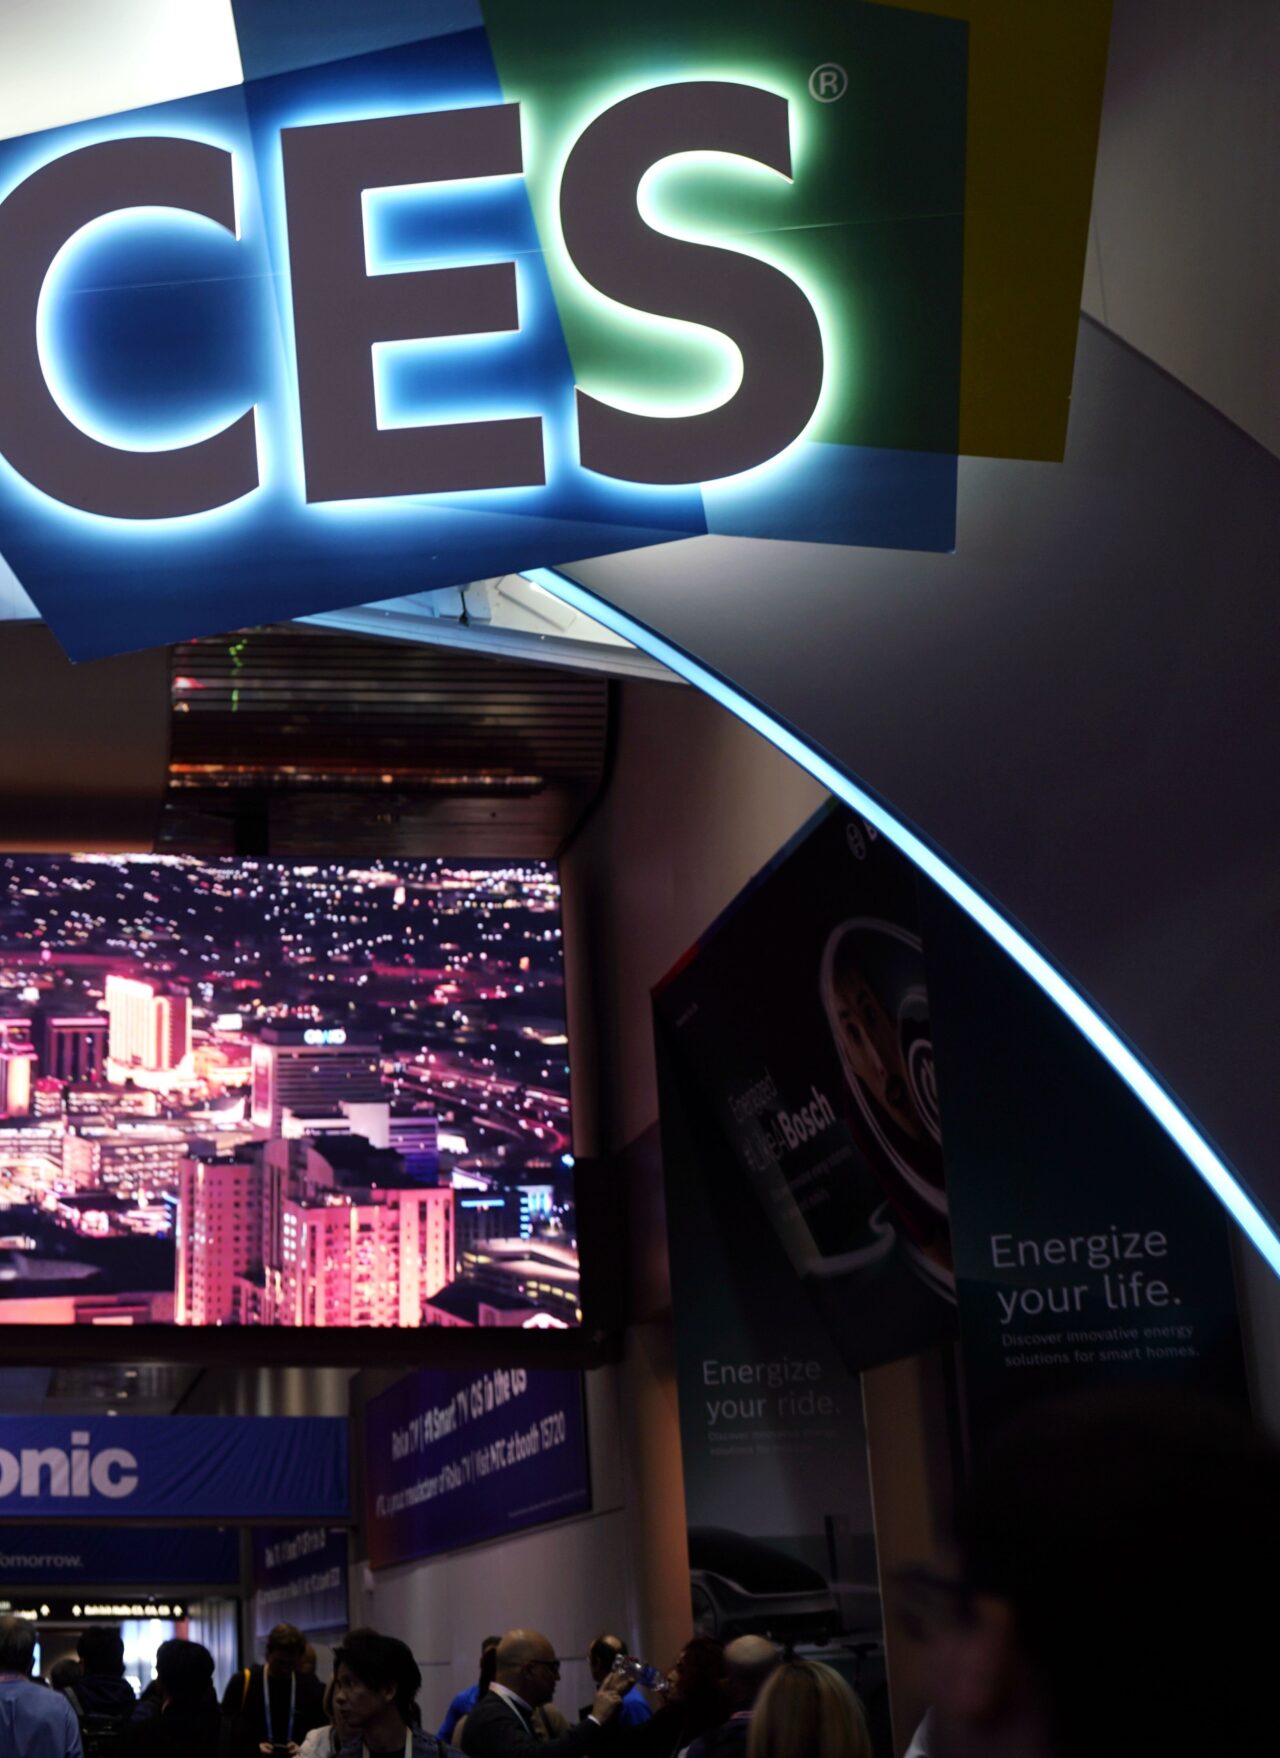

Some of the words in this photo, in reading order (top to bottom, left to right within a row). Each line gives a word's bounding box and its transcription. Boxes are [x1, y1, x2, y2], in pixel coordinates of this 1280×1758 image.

[990, 1224, 1169, 1270] Energize
[996, 1284, 1088, 1325] your
[1103, 1270, 1182, 1310] life.
[1001, 1330, 1062, 1348] Discover
[1066, 1326, 1139, 1346] innovative
[1144, 1324, 1194, 1340] energy
[1004, 1349, 1070, 1368] solutions
[1074, 1348, 1095, 1364] for
[1099, 1345, 1141, 1362] smart
[1146, 1340, 1201, 1358] homes.
[702, 1356, 822, 1388] Energize
[705, 1398, 766, 1426] your
[777, 1390, 841, 1417] ride.
